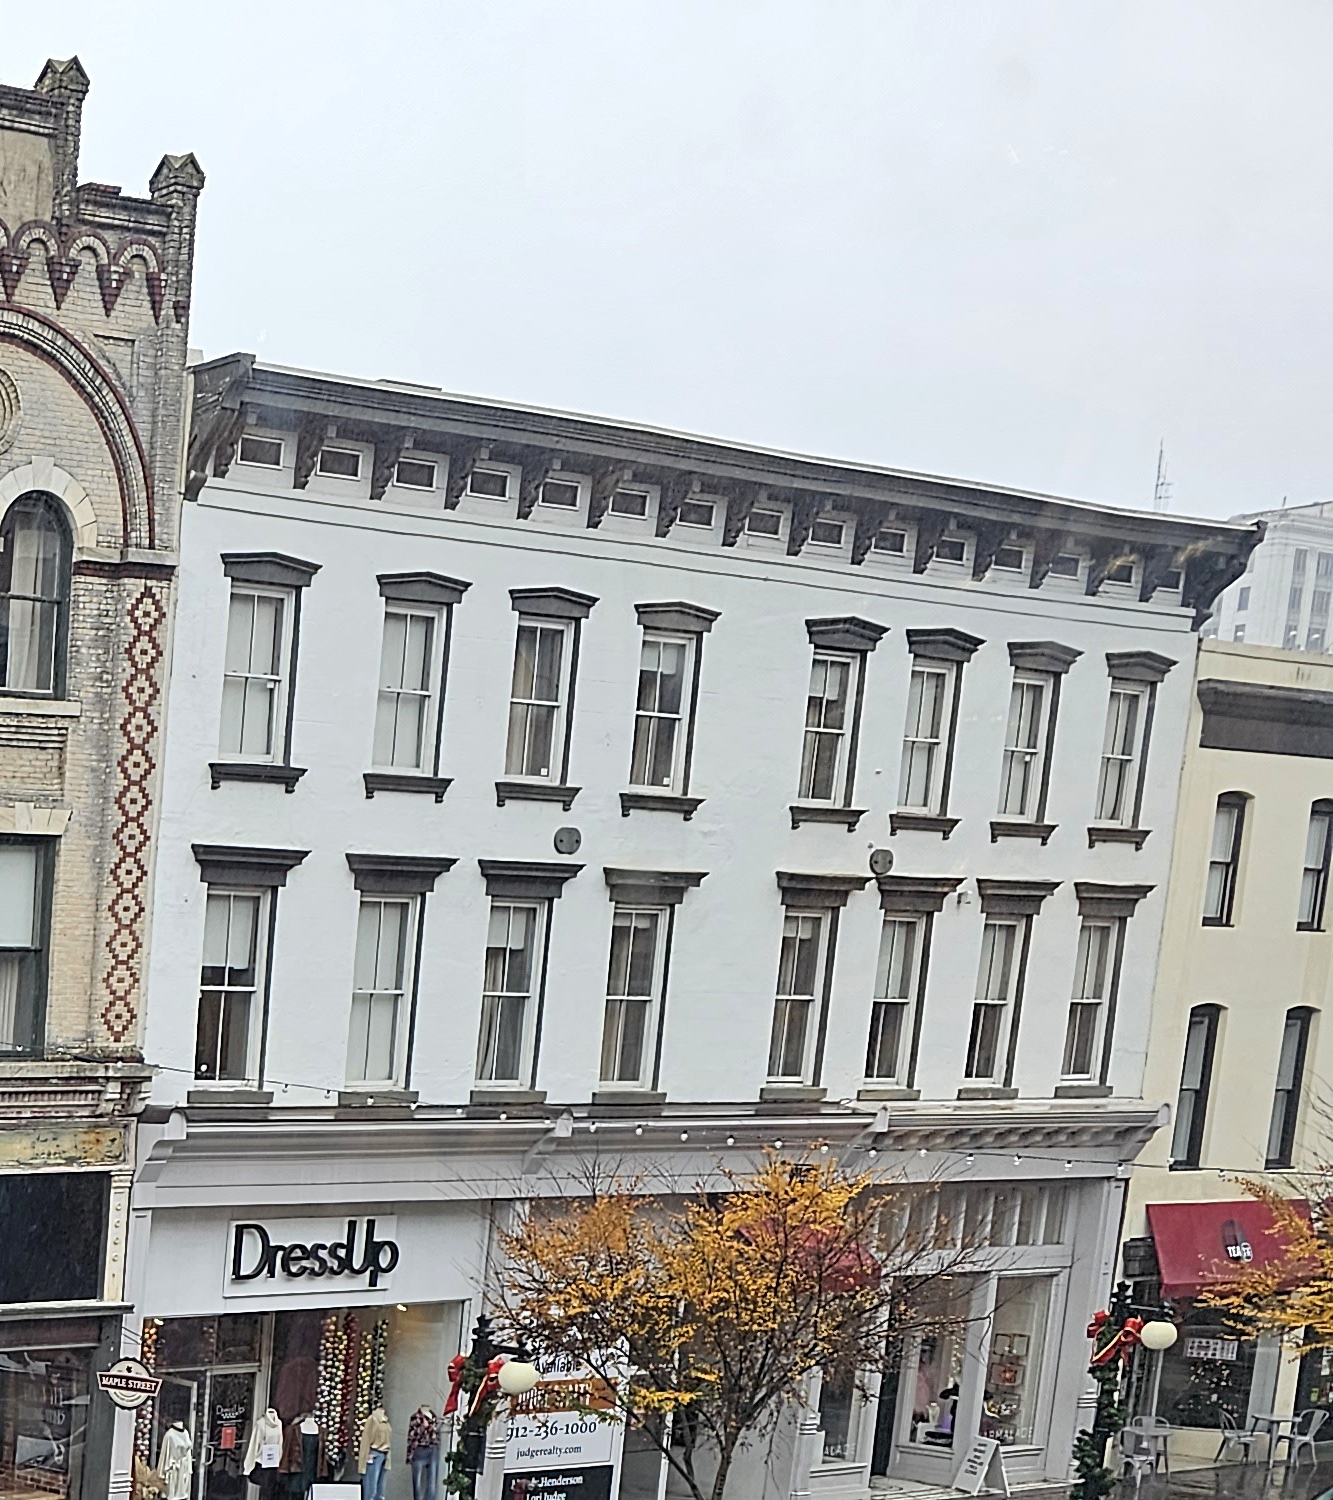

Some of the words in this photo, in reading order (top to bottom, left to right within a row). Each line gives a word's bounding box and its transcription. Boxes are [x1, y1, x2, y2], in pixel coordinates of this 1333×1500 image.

[231, 1219, 399, 1287] DressUp
[101, 1376, 127, 1388] MAPLE
[128, 1379, 156, 1391] STREET
[506, 1421, 597, 1442] 912-236-1000
[516, 1445, 582, 1460] judgerealty.com
[539, 1475, 584, 1487] Henderson
